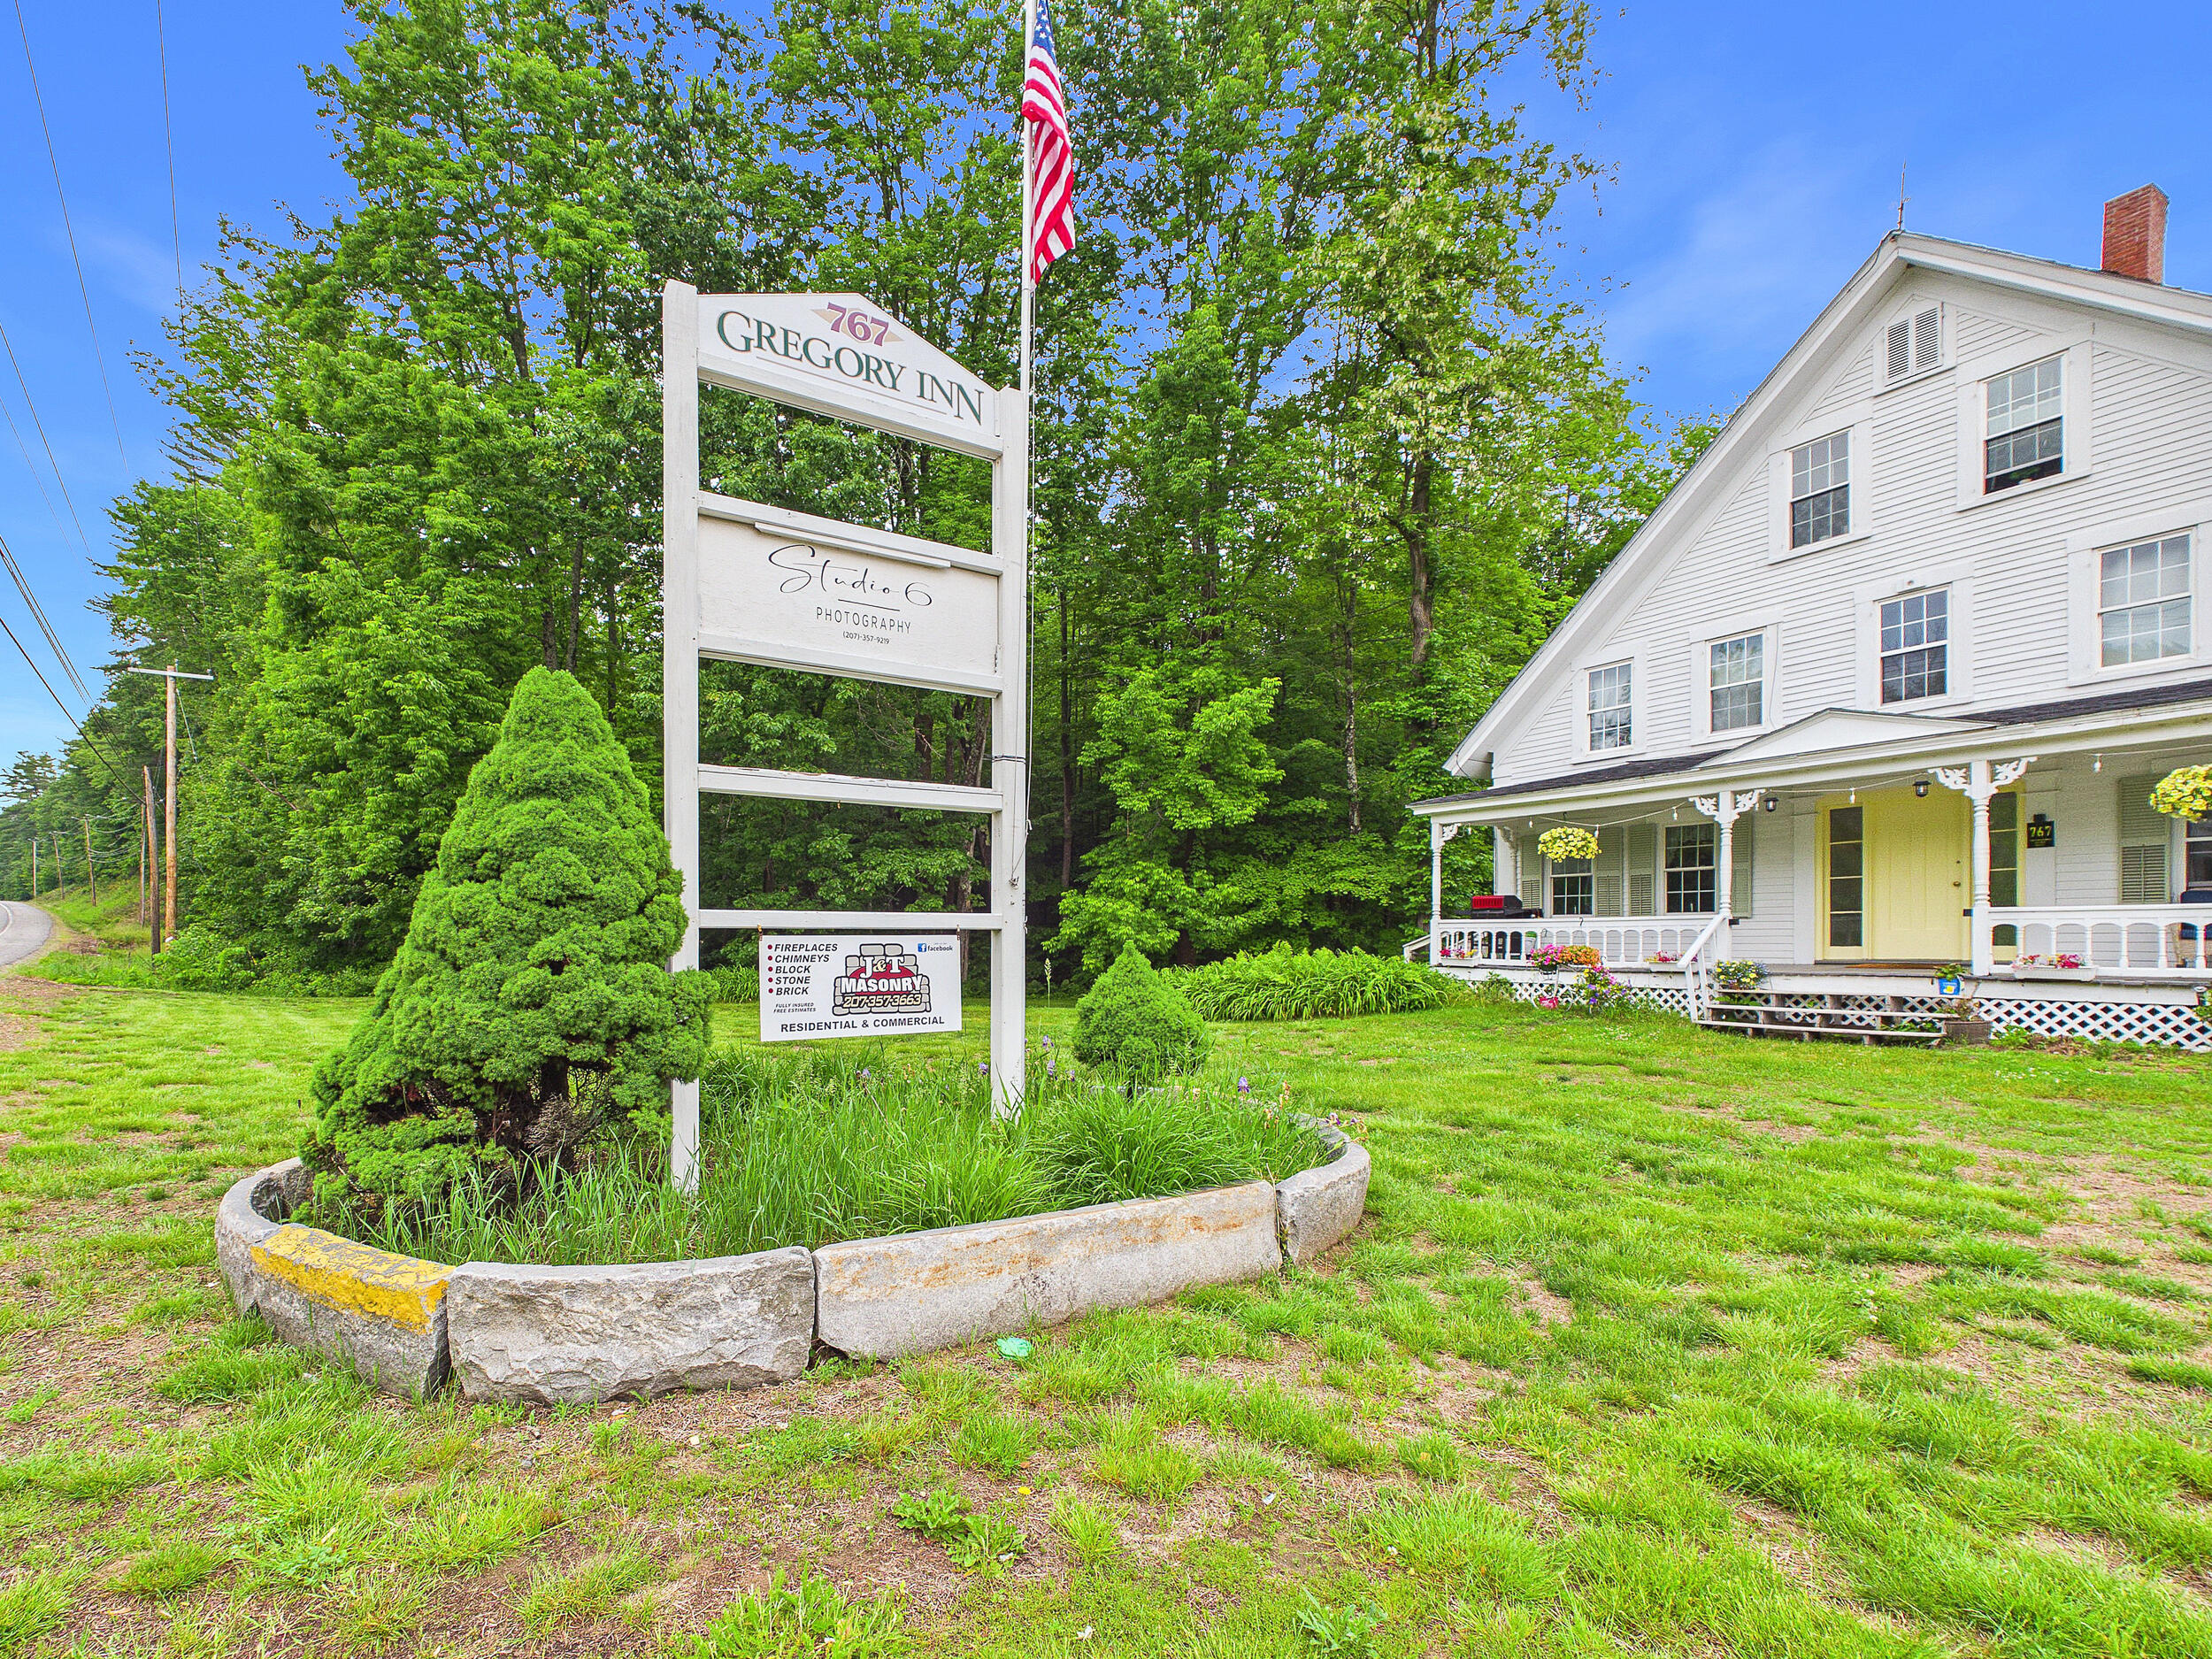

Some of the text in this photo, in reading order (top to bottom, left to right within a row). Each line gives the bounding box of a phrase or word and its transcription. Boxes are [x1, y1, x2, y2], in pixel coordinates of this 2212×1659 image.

[826, 302, 890, 347] 767
[717, 310, 985, 426] GREGORY INN
[768, 544, 896, 594] Studio
[816, 606, 912, 634] PHOTOGRAPHY
[2030, 826, 2052, 837] 767
[774, 943, 838, 952] FIREPLACES
[775, 965, 811, 974] BLOCK
[859, 956, 905, 979] J&T
[775, 976, 811, 985] STONE
[841, 974, 923, 994] MASONRY
[775, 987, 809, 995] BRICK
[842, 994, 922, 1008] 207-357-3663
[780, 1016, 945, 1033] RESIDENTIAL & COMMERCIAL
